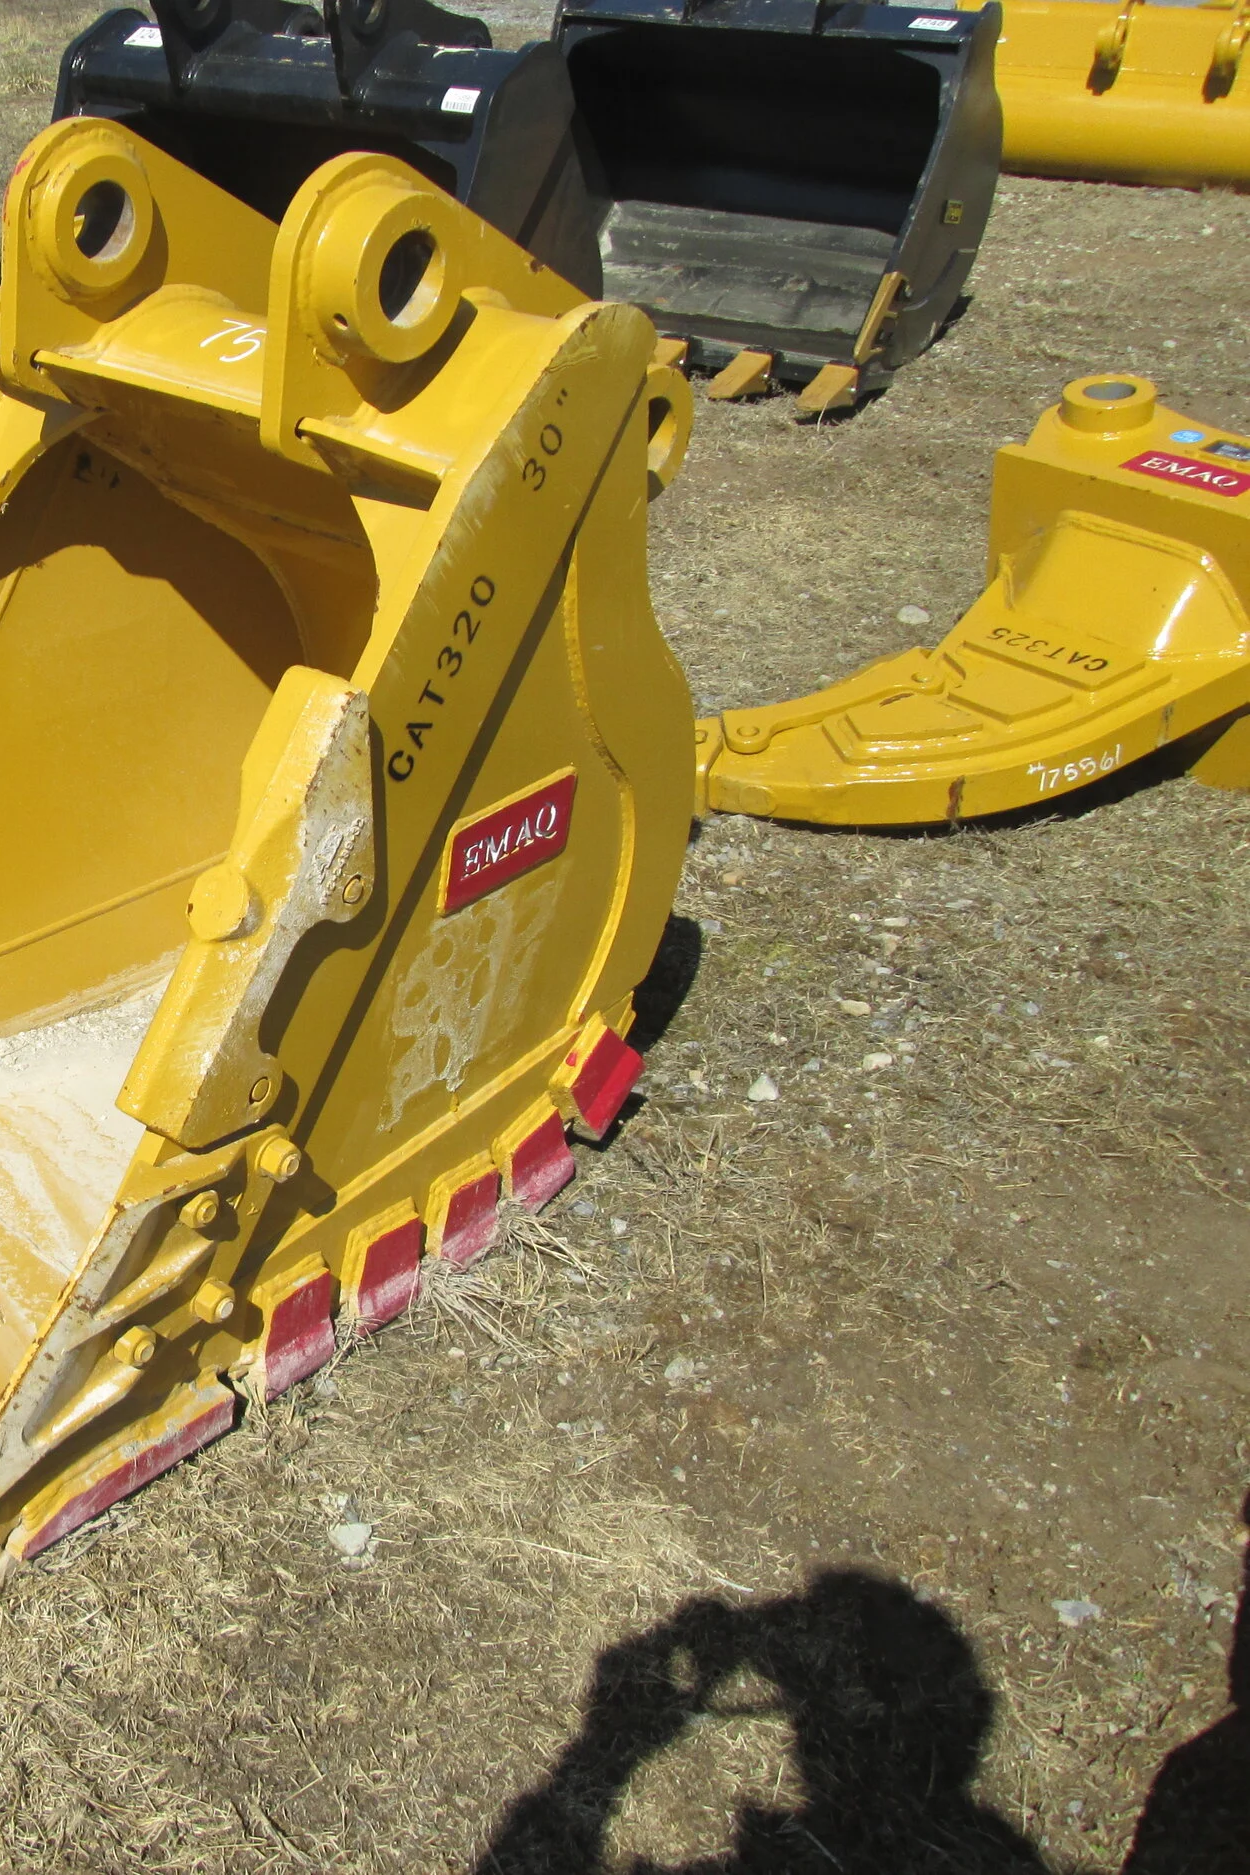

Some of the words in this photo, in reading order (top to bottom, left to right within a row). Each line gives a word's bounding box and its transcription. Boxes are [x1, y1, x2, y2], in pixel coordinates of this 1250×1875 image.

[199, 318, 268, 363] 75
[1140, 456, 1239, 488] EMAQ
[984, 627, 1109, 673] CAT325
[387, 573, 496, 784] CAT320
[461, 800, 559, 879] EMAQ
